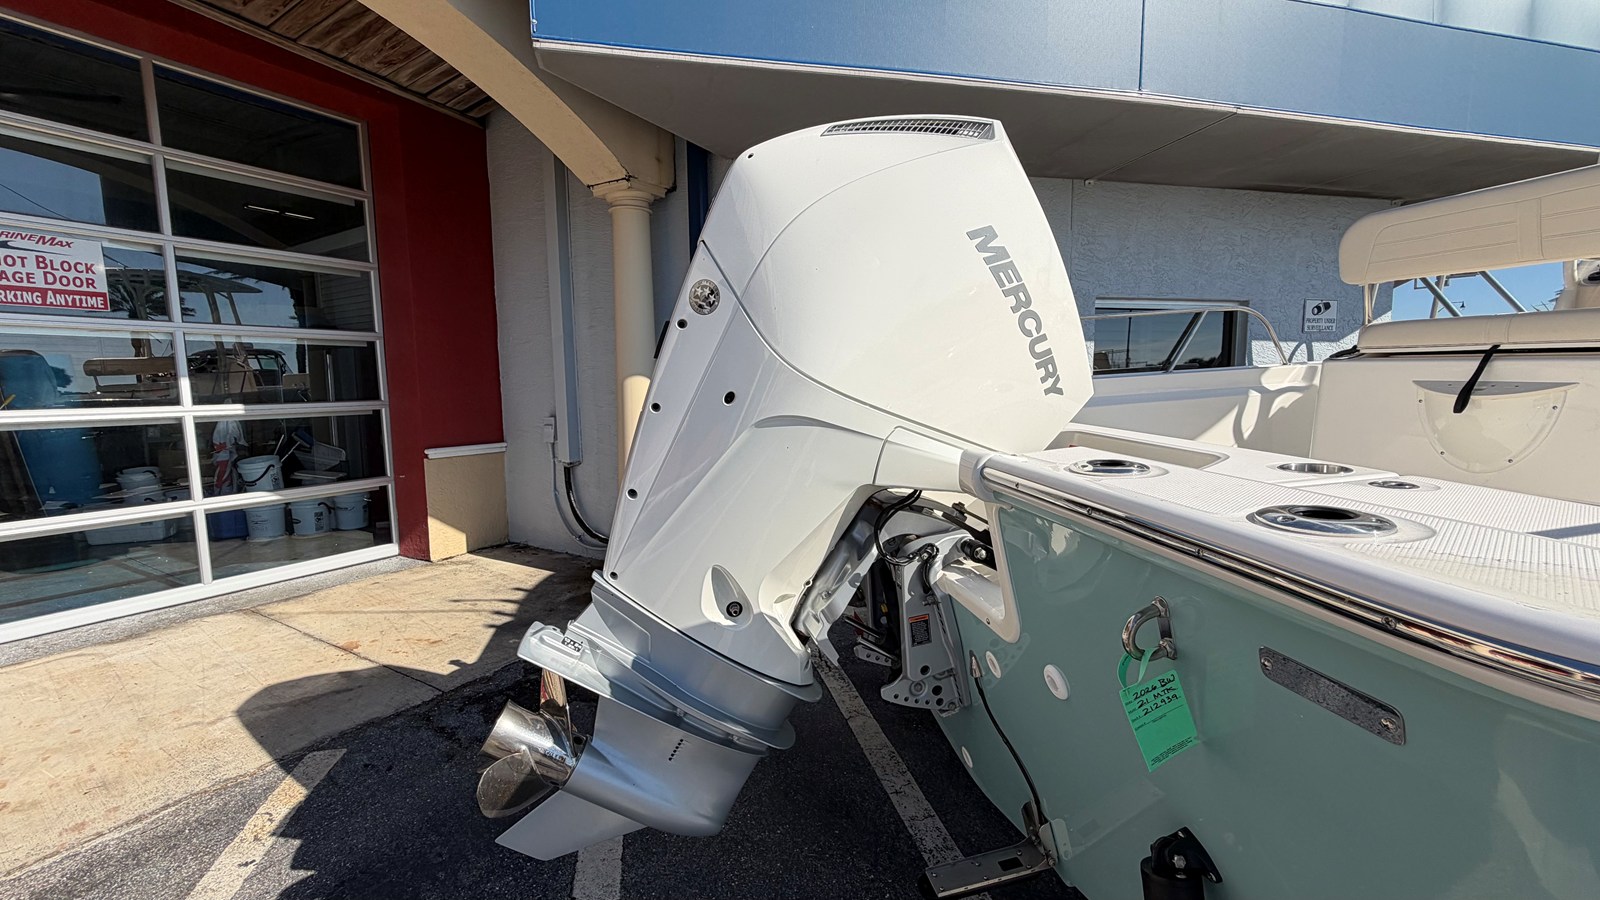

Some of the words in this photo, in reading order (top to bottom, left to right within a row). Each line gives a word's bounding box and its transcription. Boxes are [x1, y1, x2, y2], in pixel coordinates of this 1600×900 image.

[0, 255, 27, 268] OT
[35, 255, 96, 275] BLOCK
[0, 270, 36, 284] AGE
[43, 271, 97, 289] DOOR
[46, 291, 104, 308] ANYTIME
[966, 225, 1064, 396] MERCURY
[1133, 685, 1157, 700] 2026
